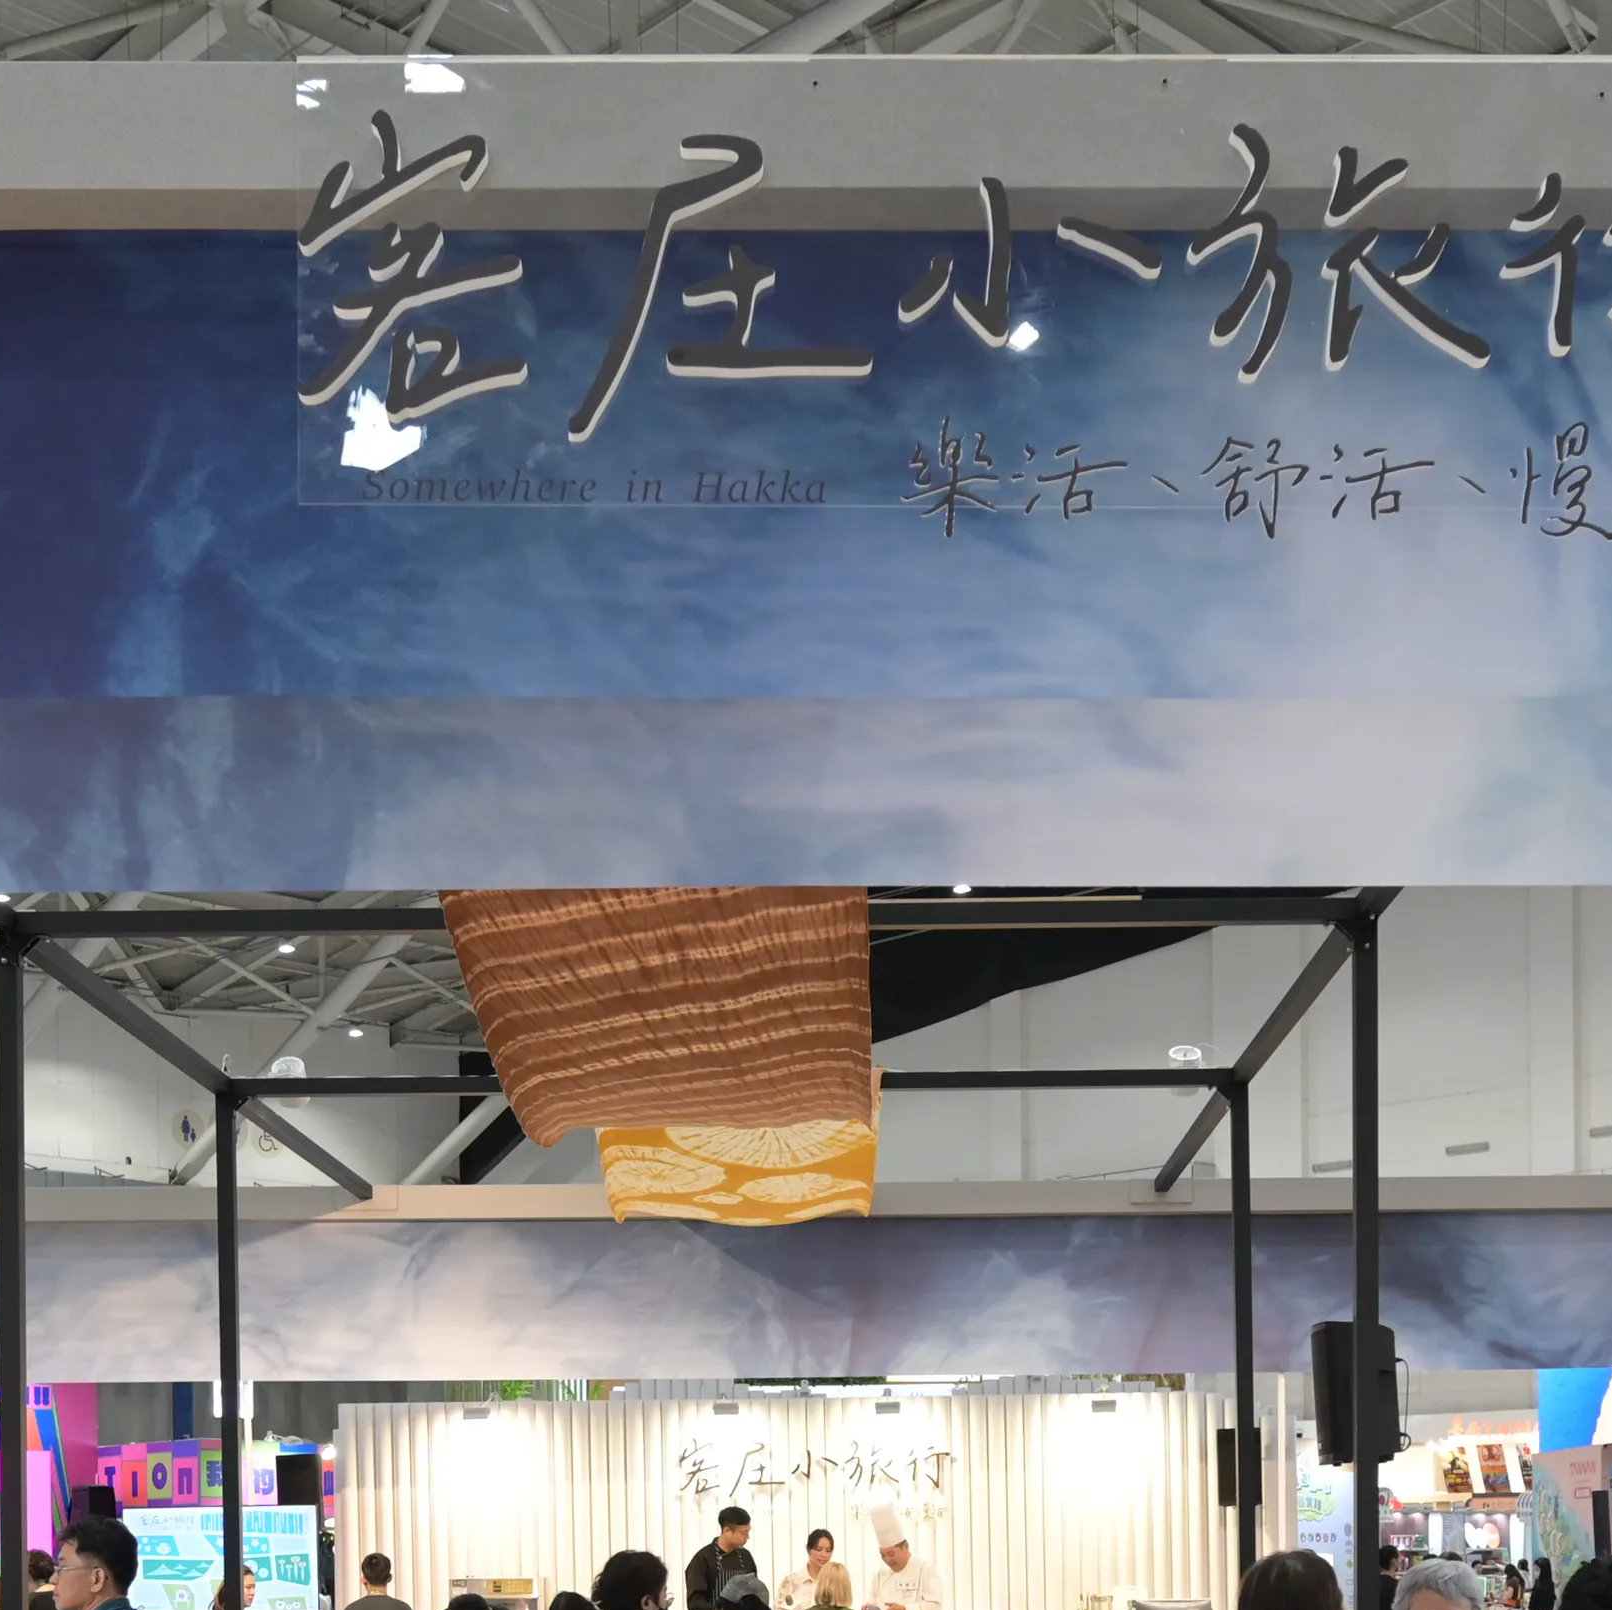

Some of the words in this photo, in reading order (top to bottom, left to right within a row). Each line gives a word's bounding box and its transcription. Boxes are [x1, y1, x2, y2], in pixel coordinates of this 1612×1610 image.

[363, 468, 598, 502] Somewhere
[626, 470, 663, 502] in
[693, 470, 828, 503] Hakka
